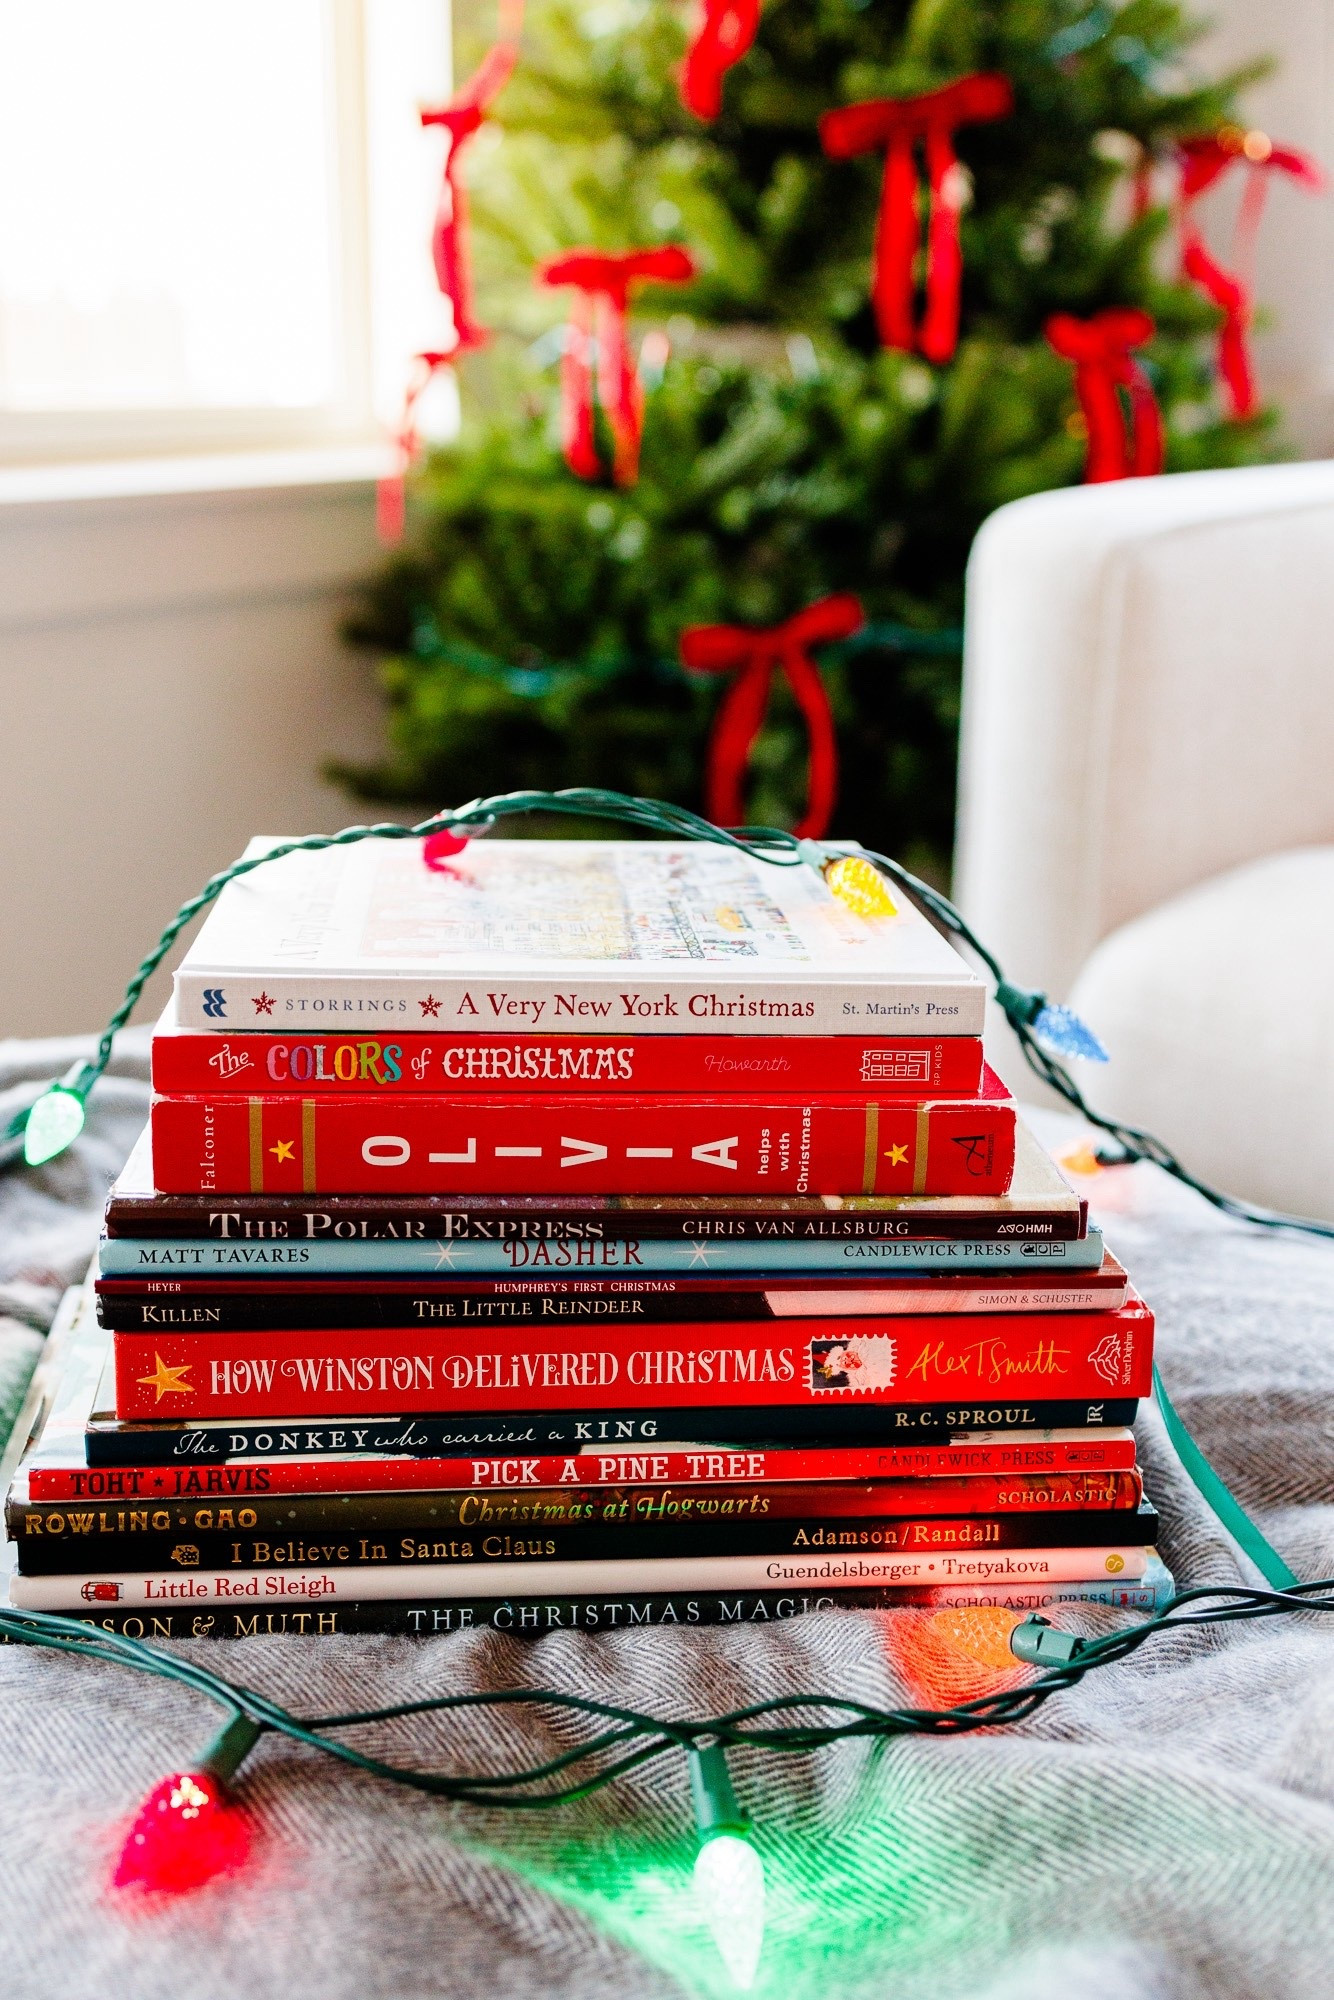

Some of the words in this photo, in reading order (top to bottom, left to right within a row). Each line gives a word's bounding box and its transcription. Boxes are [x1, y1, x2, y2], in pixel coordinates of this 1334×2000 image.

[285, 998, 407, 1012] STORRINGS
[456, 992, 480, 1015] A
[487, 993, 546, 1023] Very
[554, 994, 612, 1017] New
[620, 994, 679, 1016] York
[688, 994, 815, 1017] Christmas
[842, 1002, 860, 1015] St.
[866, 1002, 920, 1015] Martin's
[925, 1003, 959, 1015] Press
[208, 1043, 254, 1079] The
[267, 1041, 403, 1085] COLORS
[411, 1047, 432, 1080] of
[704, 1054, 791, 1073] Howarth
[200, 1104, 216, 1190] Falconer
[361, 1135, 739, 1171] OLIVIA
[758, 1128, 772, 1174] helps
[779, 1132, 790, 1171] with
[796, 1107, 812, 1193] Christmas
[682, 1221, 745, 1235] CHRIS
[755, 1221, 796, 1235] VAN
[804, 1221, 910, 1235] ALLSBURG
[1025, 1224, 1053, 1233] HMH
[139, 1249, 204, 1263] MATT
[213, 1248, 310, 1263] TAVARES
[502, 1240, 643, 1267] DASHER
[844, 1244, 958, 1257] CANDLEWICK
[964, 1244, 1011, 1256] PRESS
[147, 1282, 181, 1292] HEYER
[494, 1282, 568, 1293] HUMPHREY'S
[574, 1282, 604, 1292] FIRST
[610, 1281, 676, 1292] CHRISTMAS
[978, 1295, 1017, 1304] SIMON
[1020, 1295, 1030, 1304] &
[1033, 1294, 1093, 1304] SCHUSTER
[1122, 1331, 1135, 1362] Dolphin
[905, 1340, 975, 1381] Alex
[988, 1340, 1072, 1384] Smith
[209, 1359, 277, 1395] HOW
[895, 1412, 939, 1427] R.C.
[946, 1409, 1036, 1425] SPROUL
[173, 1430, 220, 1455] The
[229, 1430, 369, 1452] DONKEY
[374, 1422, 429, 1447] who
[442, 1424, 537, 1445] carried
[548, 1431, 565, 1440] a
[574, 1420, 659, 1439] KING
[471, 1459, 541, 1485] PICK
[559, 1458, 580, 1483] A
[598, 1456, 669, 1481] PINE
[686, 1453, 765, 1479] TREE
[1001, 1450, 1055, 1466] PRESS
[70, 1472, 145, 1496] TOHT
[172, 1468, 271, 1495] JARVIS
[458, 1496, 593, 1526] Christmas
[602, 1500, 629, 1518] at
[636, 1489, 771, 1521] Hogwarts
[998, 1489, 1117, 1505] SCHOLASTIC
[25, 1510, 171, 1535] ROWLING
[194, 1508, 258, 1529] GAO
[231, 1543, 243, 1563] I
[252, 1540, 349, 1563] Believe
[358, 1539, 388, 1560] In
[400, 1538, 474, 1559] Santa
[482, 1536, 556, 1556] Claus
[766, 1560, 921, 1581] Guendelsberger
[942, 1558, 1049, 1580] Tretyakova
[144, 1579, 208, 1599] Little
[214, 1577, 259, 1597] Red
[265, 1575, 336, 1598] Sleigh
[233, 1611, 338, 1637] MUTH
[407, 1608, 474, 1632] THE
[493, 1600, 701, 1629] CHRISTMAS
